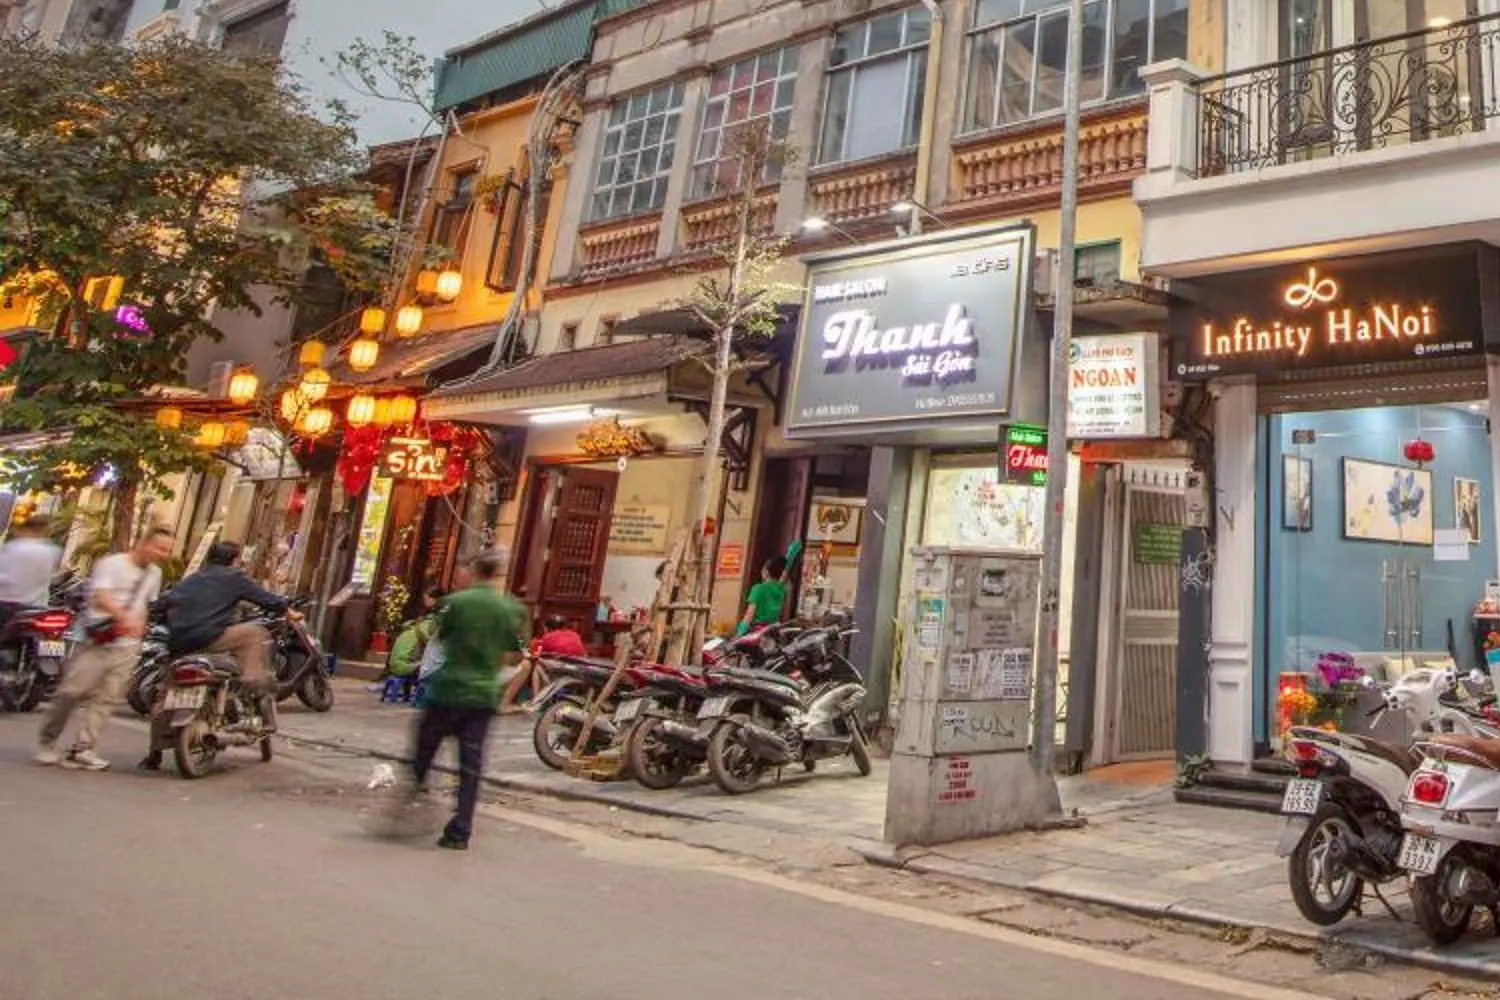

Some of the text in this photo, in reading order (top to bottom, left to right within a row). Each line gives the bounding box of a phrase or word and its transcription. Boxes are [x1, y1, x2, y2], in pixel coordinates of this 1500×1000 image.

[821, 303, 975, 360] Thanh
[1203, 303, 1434, 357] Infinity HaNoi
